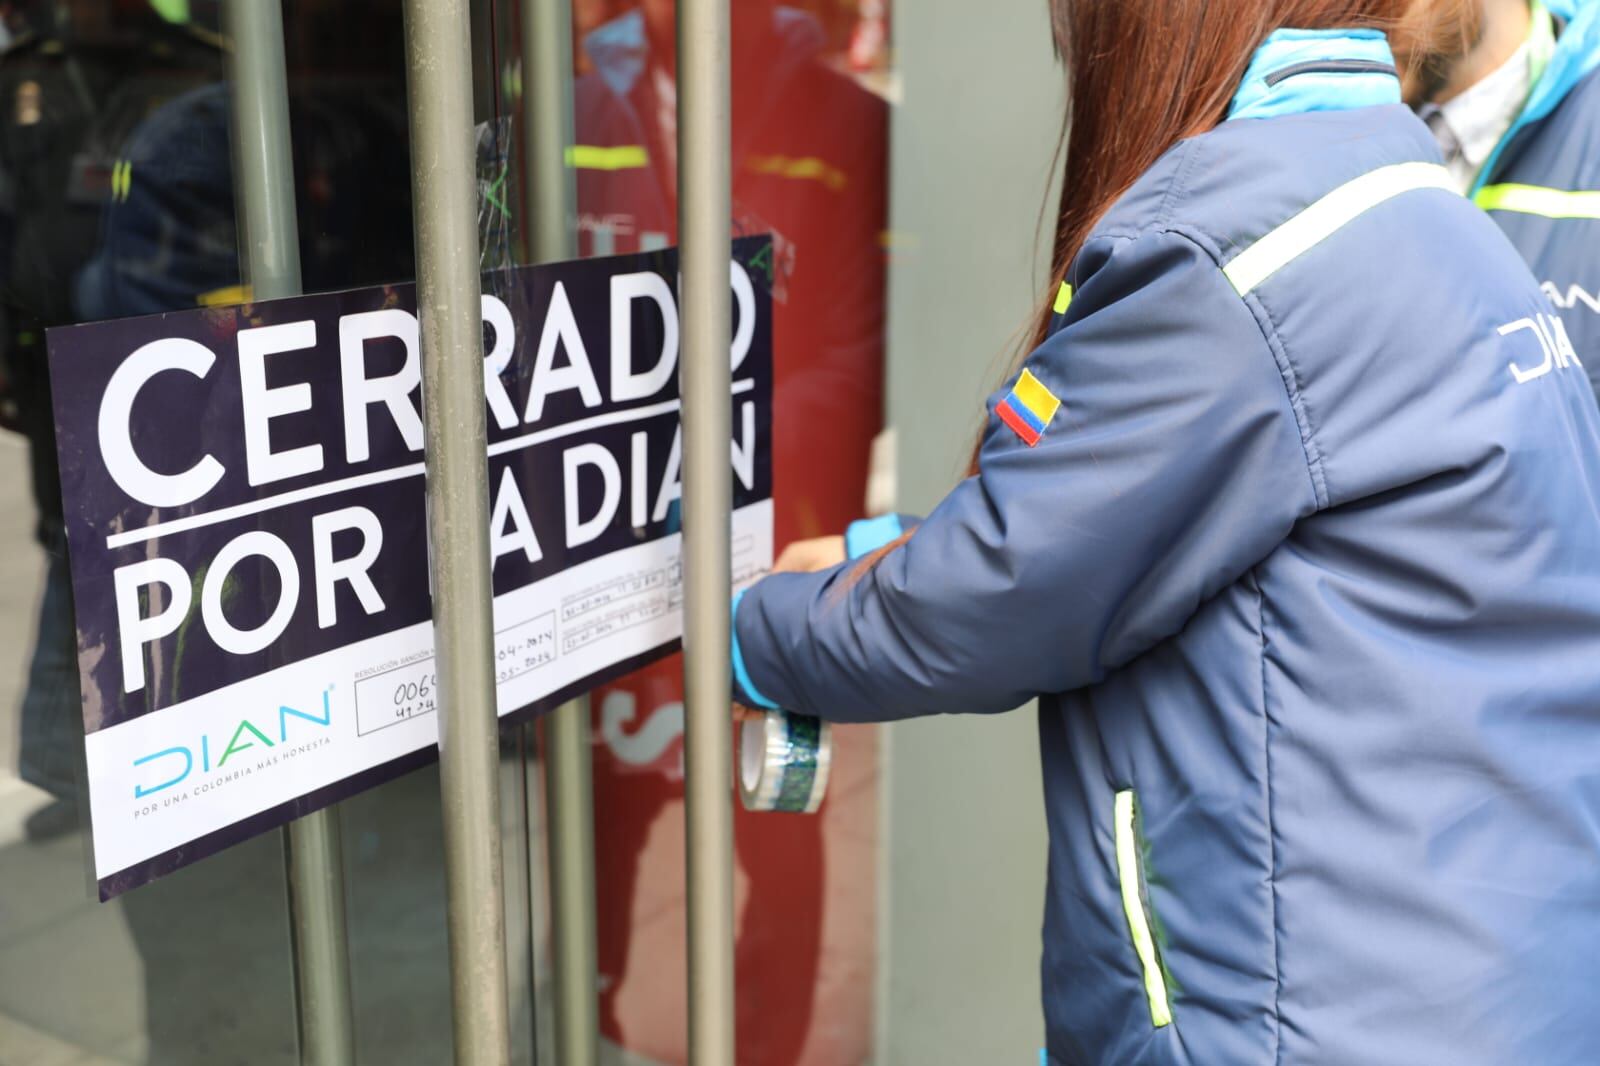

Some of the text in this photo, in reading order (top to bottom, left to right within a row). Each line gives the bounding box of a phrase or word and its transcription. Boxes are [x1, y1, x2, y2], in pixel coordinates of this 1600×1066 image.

[1497, 312, 1582, 384] DIA
[113, 505, 386, 694] POR
[133, 690, 331, 799] DIAN
[134, 736, 331, 819] POR UNA COLOMBIA MÁS HONESTA
